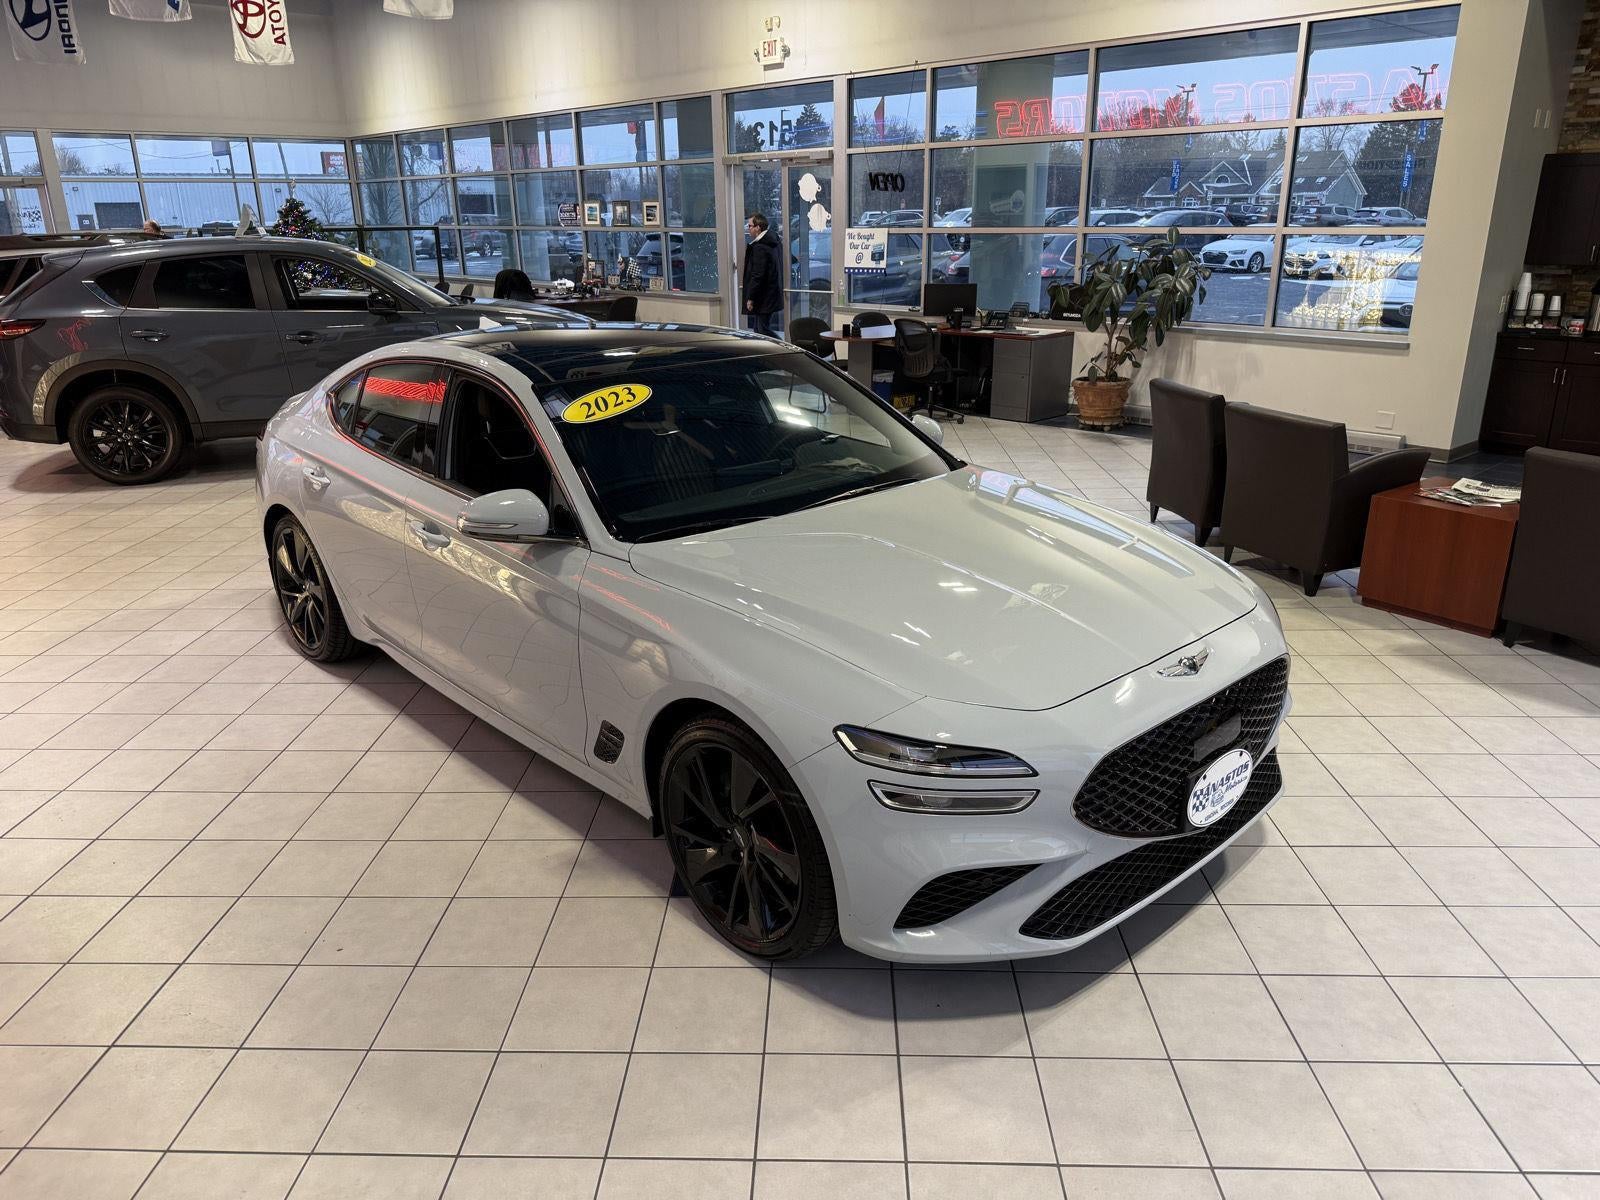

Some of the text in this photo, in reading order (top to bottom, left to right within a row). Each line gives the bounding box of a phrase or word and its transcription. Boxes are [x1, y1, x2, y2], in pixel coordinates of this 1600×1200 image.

[763, 40, 777, 57] EXIT
[1402, 154, 1412, 188] SALES
[847, 232, 875, 242] We Bought
[579, 386, 637, 419] 2023
